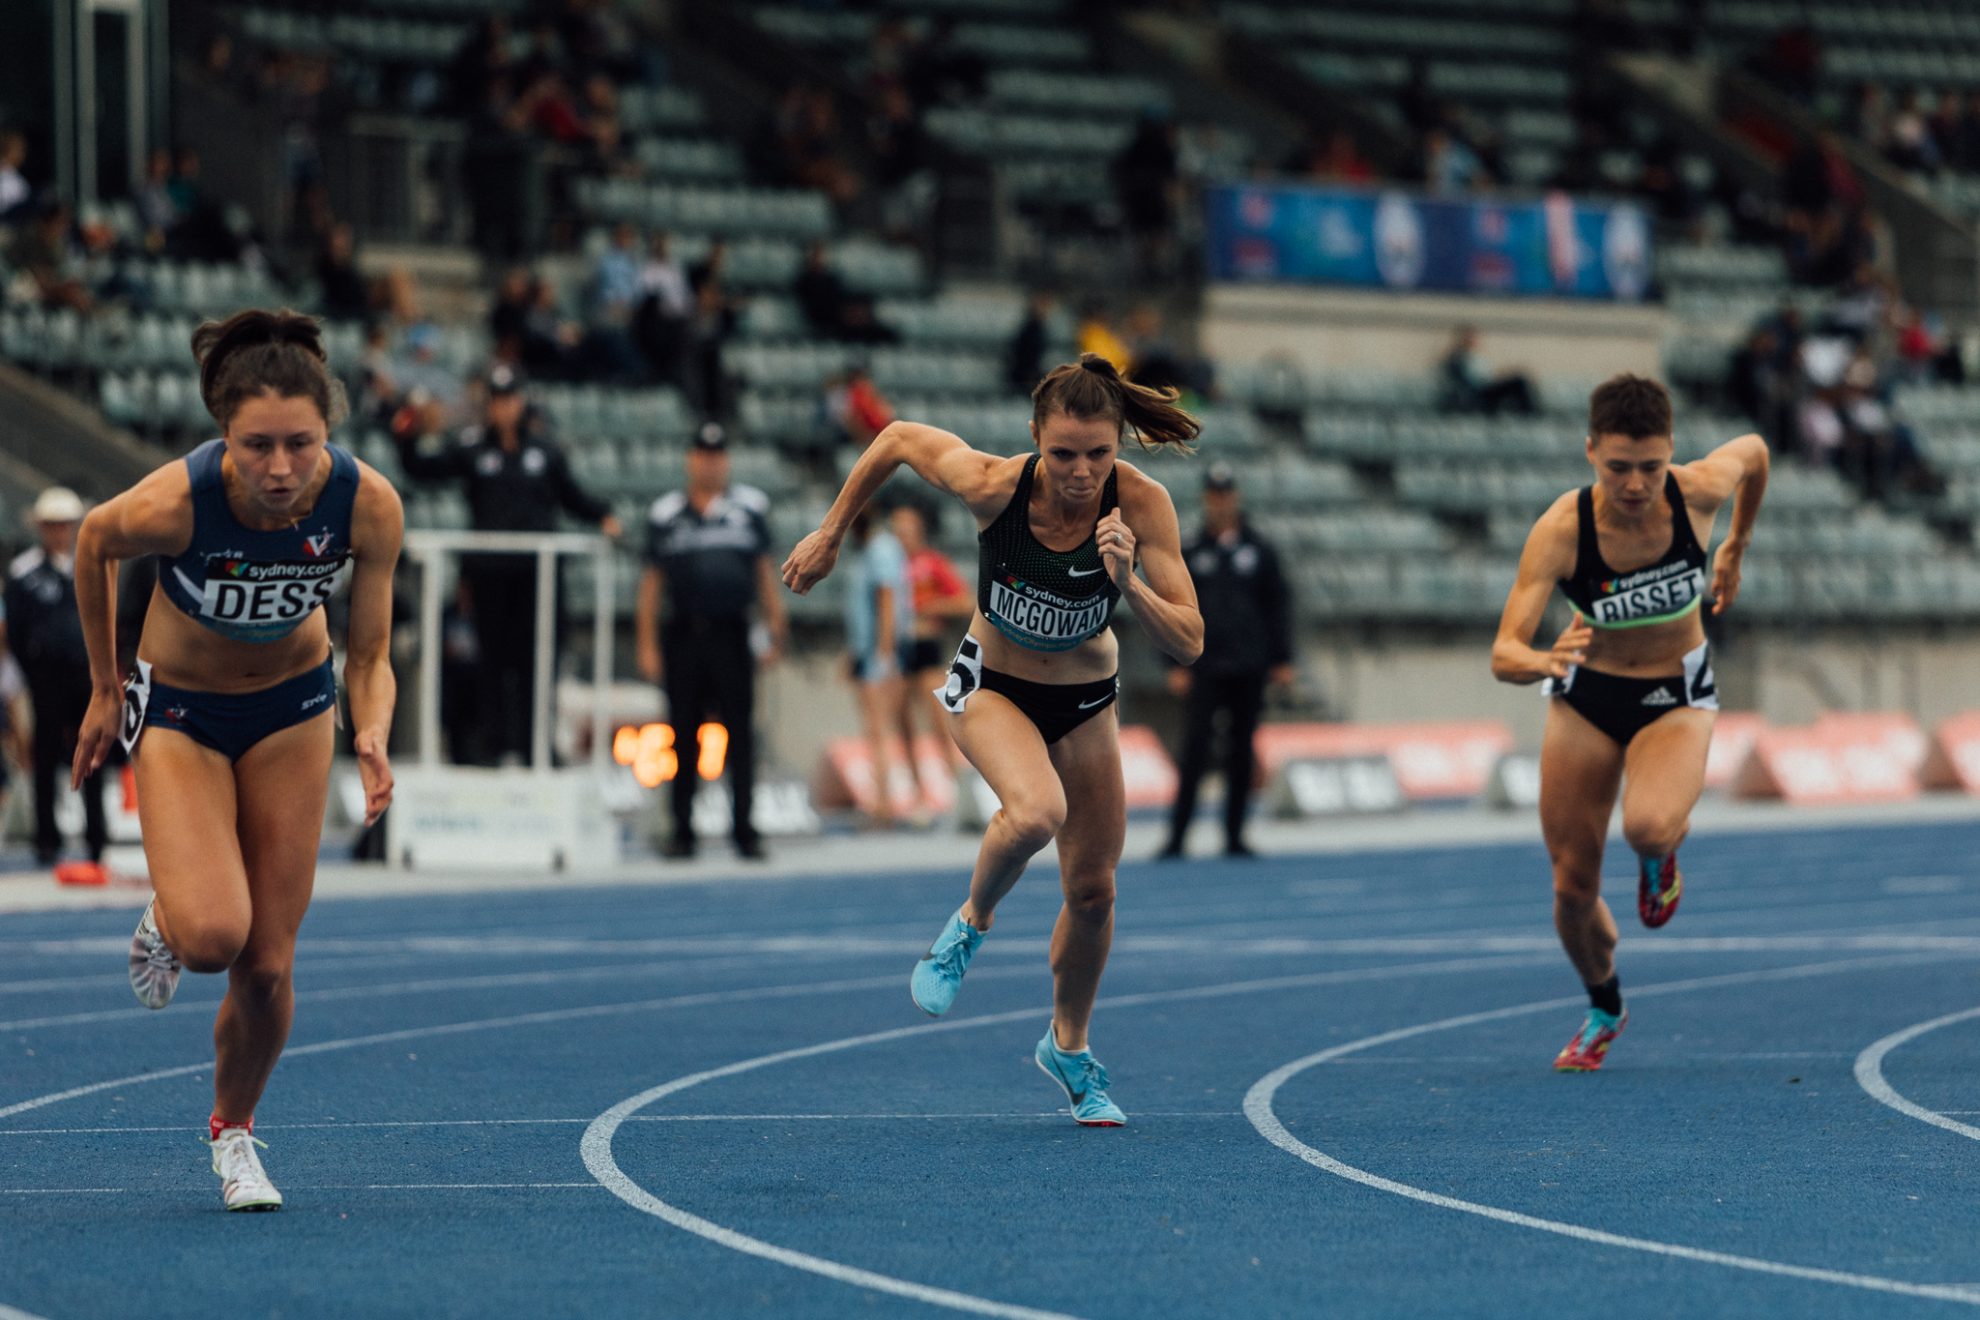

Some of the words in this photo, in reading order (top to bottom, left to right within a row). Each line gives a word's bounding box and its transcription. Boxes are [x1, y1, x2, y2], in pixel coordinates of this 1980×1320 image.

[248, 560, 339, 581] sydney.com
[213, 577, 335, 621] DESS
[996, 587, 1105, 637] MCGOWAN
[1025, 585, 1100, 609] sydney.com
[1602, 573, 1697, 622] BISSET
